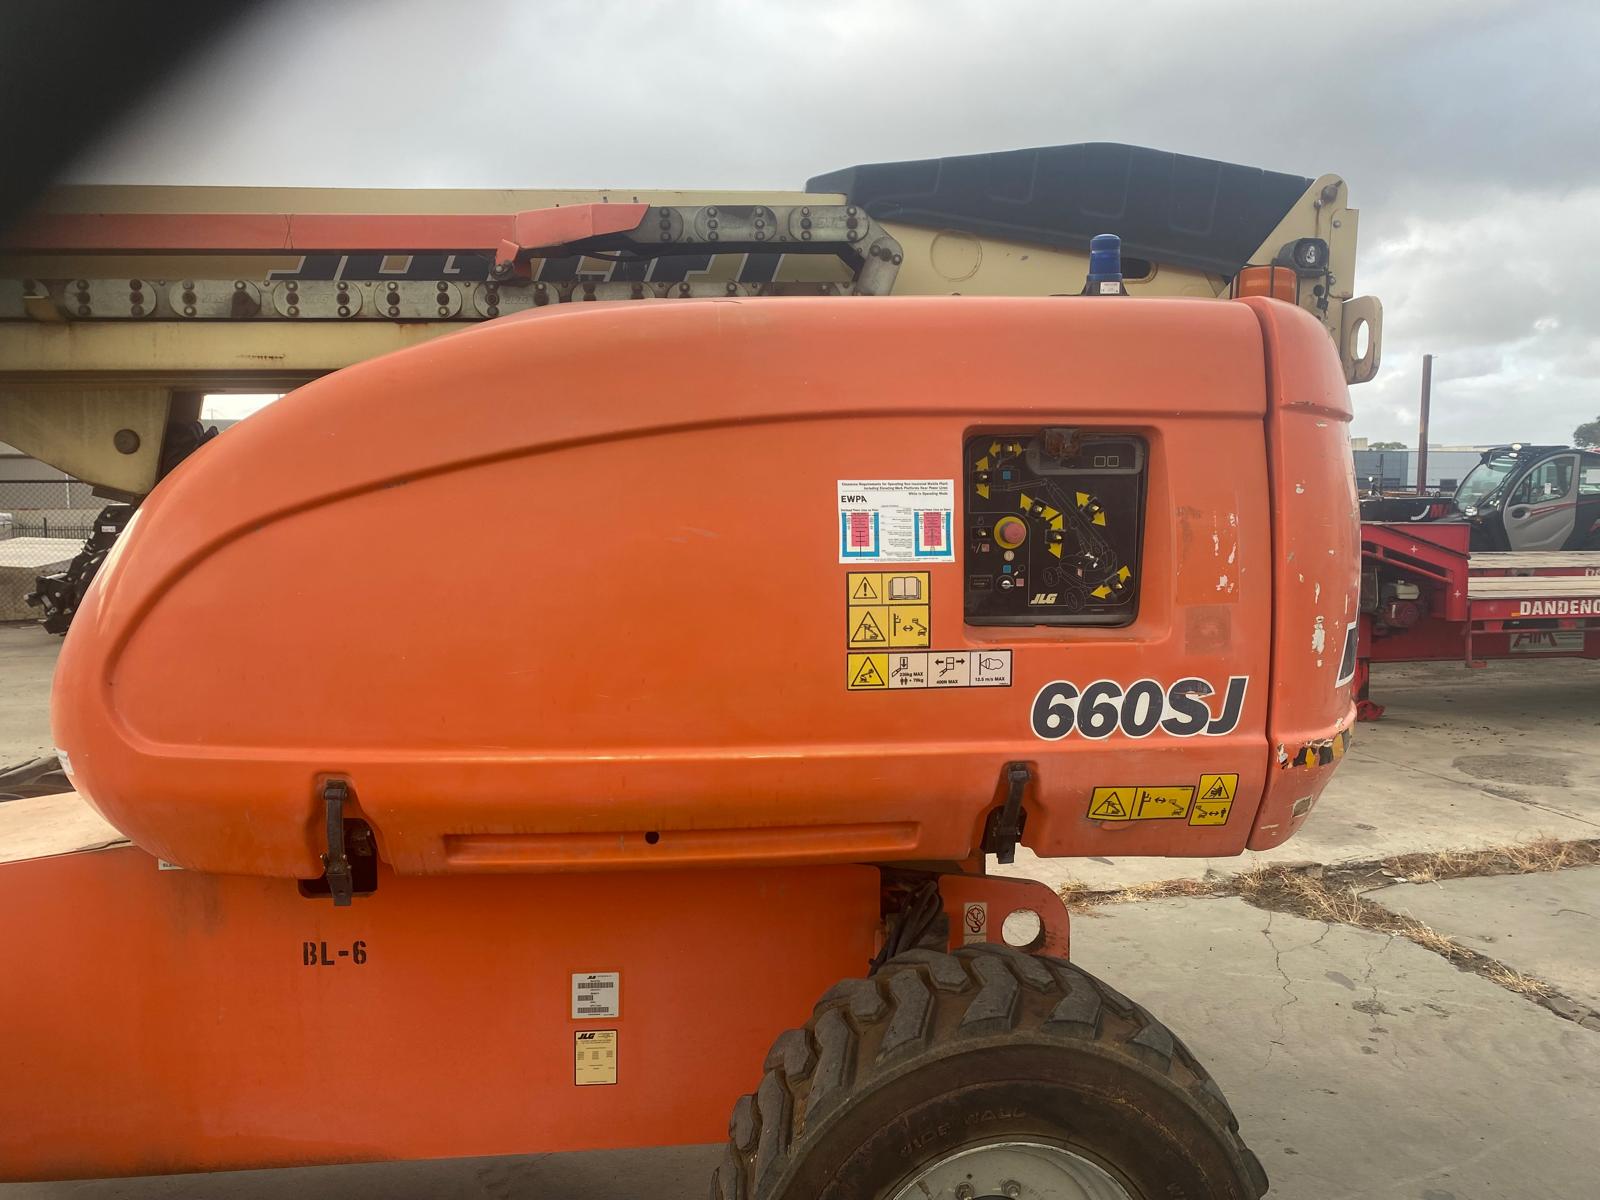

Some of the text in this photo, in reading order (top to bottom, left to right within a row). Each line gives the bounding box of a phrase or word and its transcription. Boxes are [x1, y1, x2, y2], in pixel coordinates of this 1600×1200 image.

[841, 495, 867, 503] EWPA
[1030, 593, 1058, 605] JLG
[1030, 675, 1249, 742] 660SJ
[303, 940, 367, 966] BL-6
